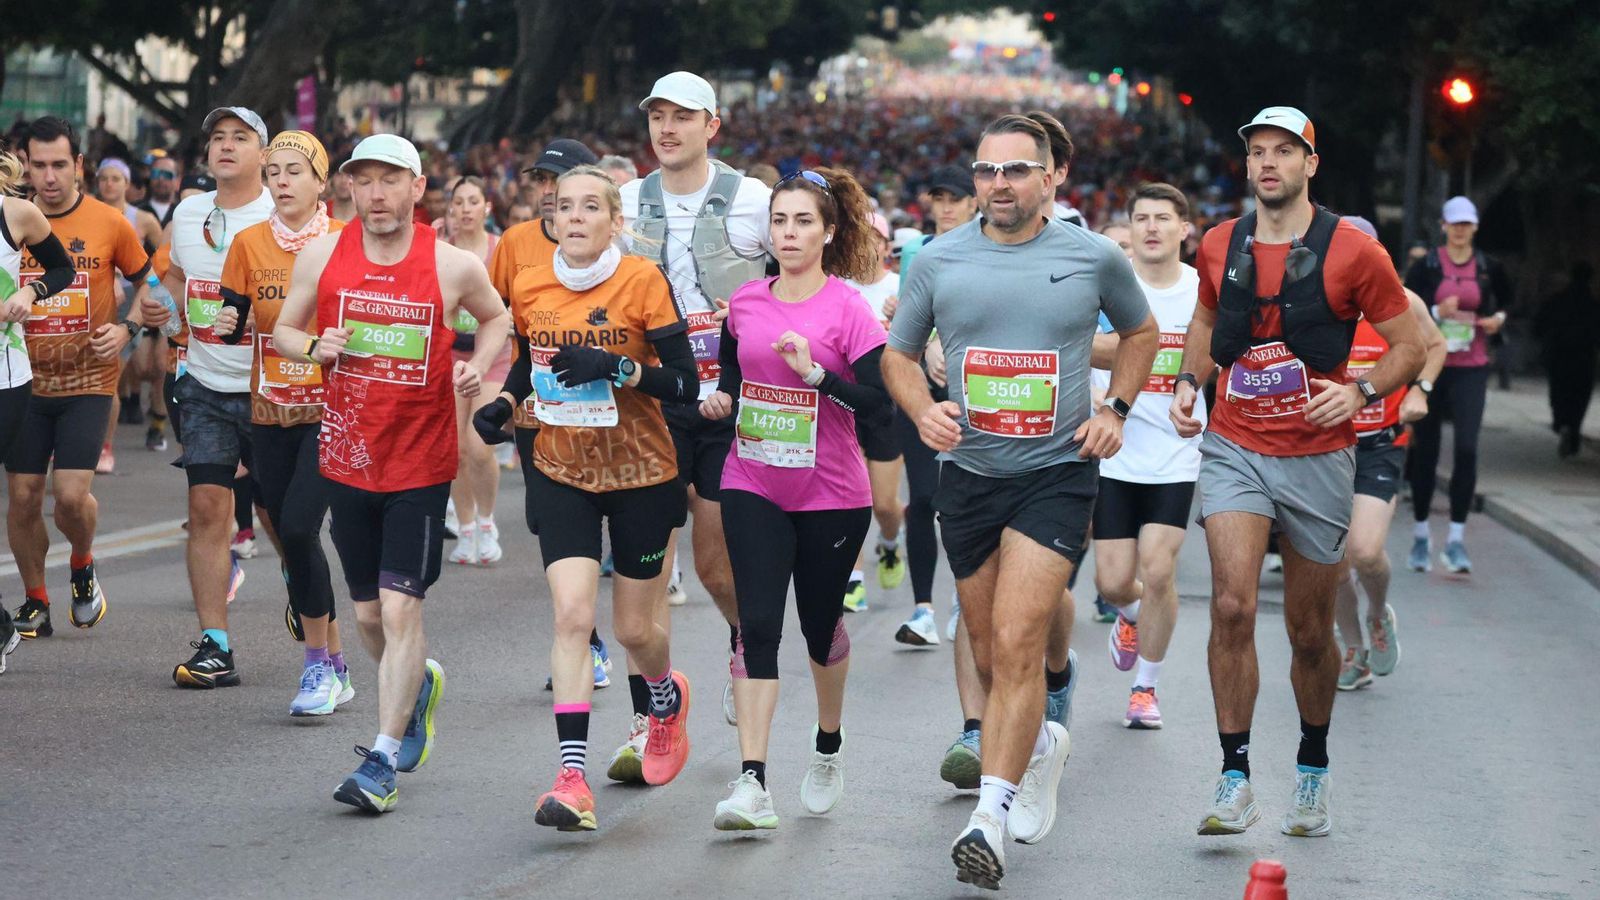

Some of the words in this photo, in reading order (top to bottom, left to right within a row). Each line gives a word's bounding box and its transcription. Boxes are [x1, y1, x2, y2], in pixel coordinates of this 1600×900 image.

[366, 302, 427, 320] GENERALI
[362, 327, 406, 347] 2602
[530, 328, 629, 349] SOLIDARIS
[279, 361, 314, 375] 5252
[988, 353, 1051, 369] GENERALI
[1242, 371, 1283, 387] 3559
[757, 387, 811, 405] GENERALI
[986, 381, 1032, 399] 3504
[827, 394, 856, 413] KIPRUN
[752, 411, 796, 432] 14709
